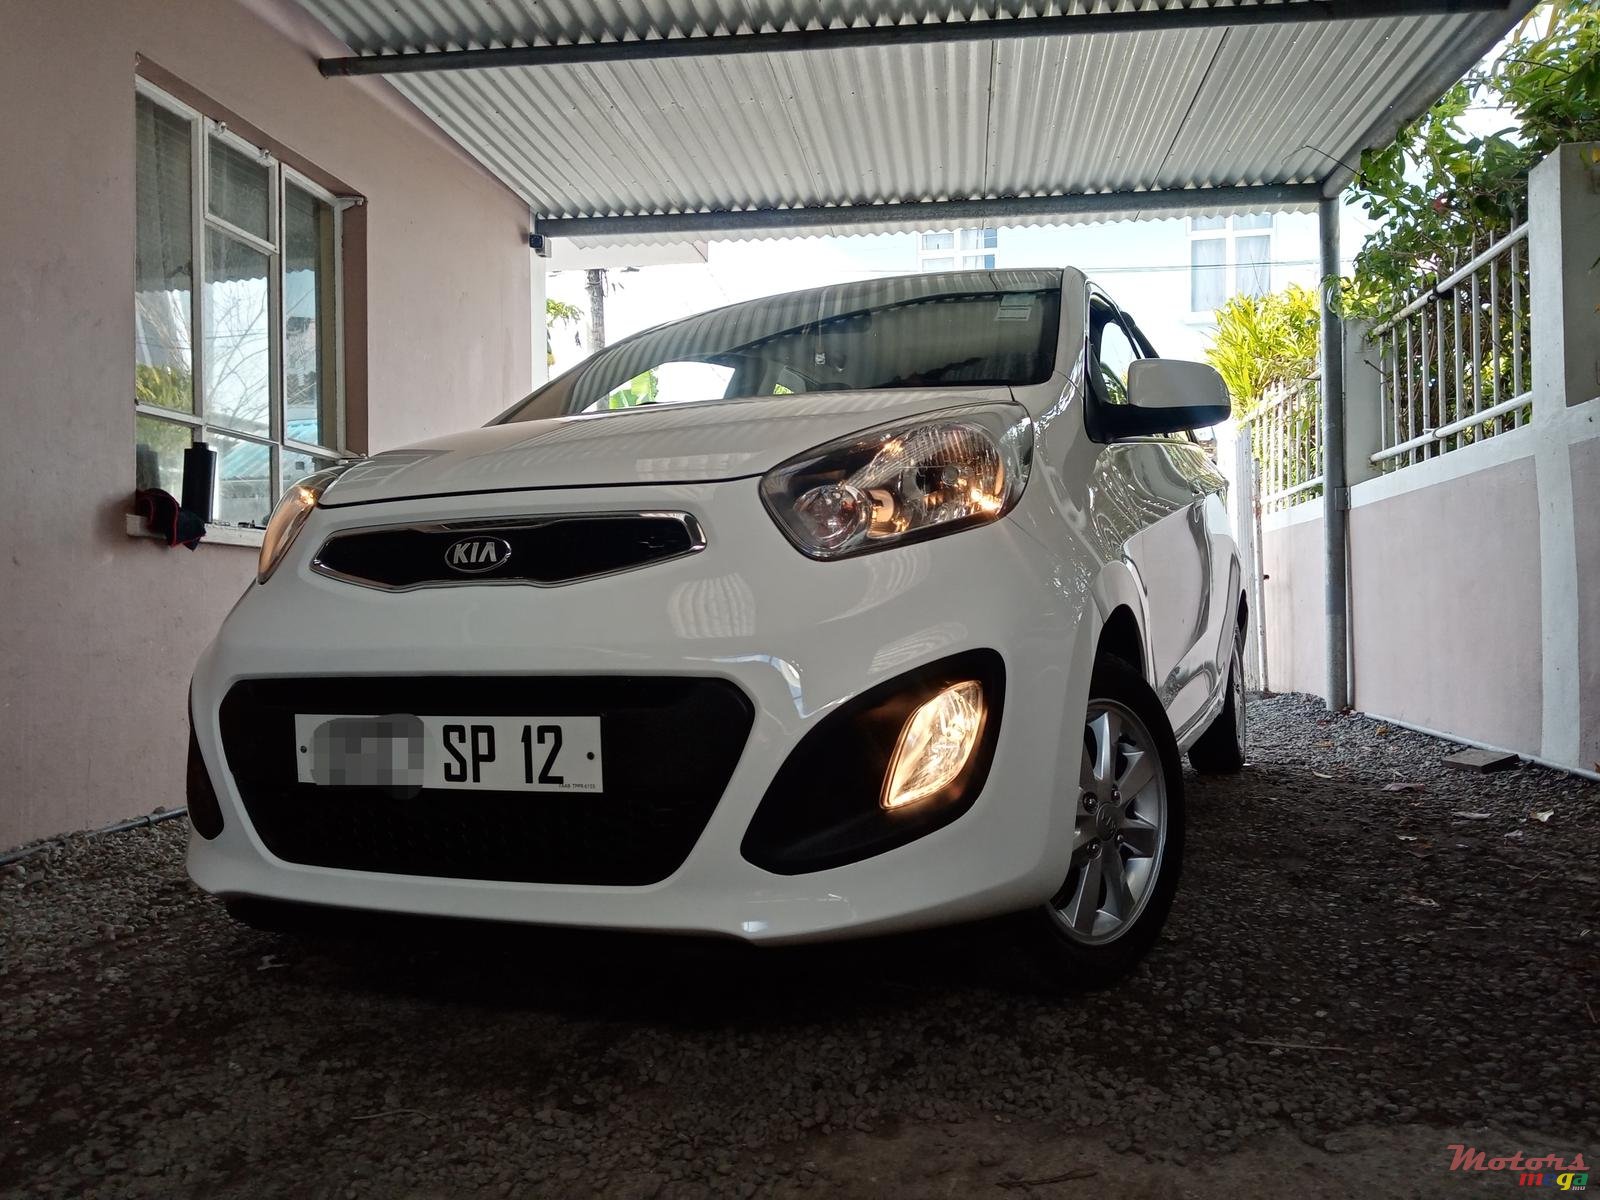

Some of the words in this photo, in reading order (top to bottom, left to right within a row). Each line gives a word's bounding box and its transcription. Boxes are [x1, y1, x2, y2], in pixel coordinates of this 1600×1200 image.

[453, 541, 497, 564] KIA
[442, 724, 496, 783] SP
[520, 725, 564, 784] 12
